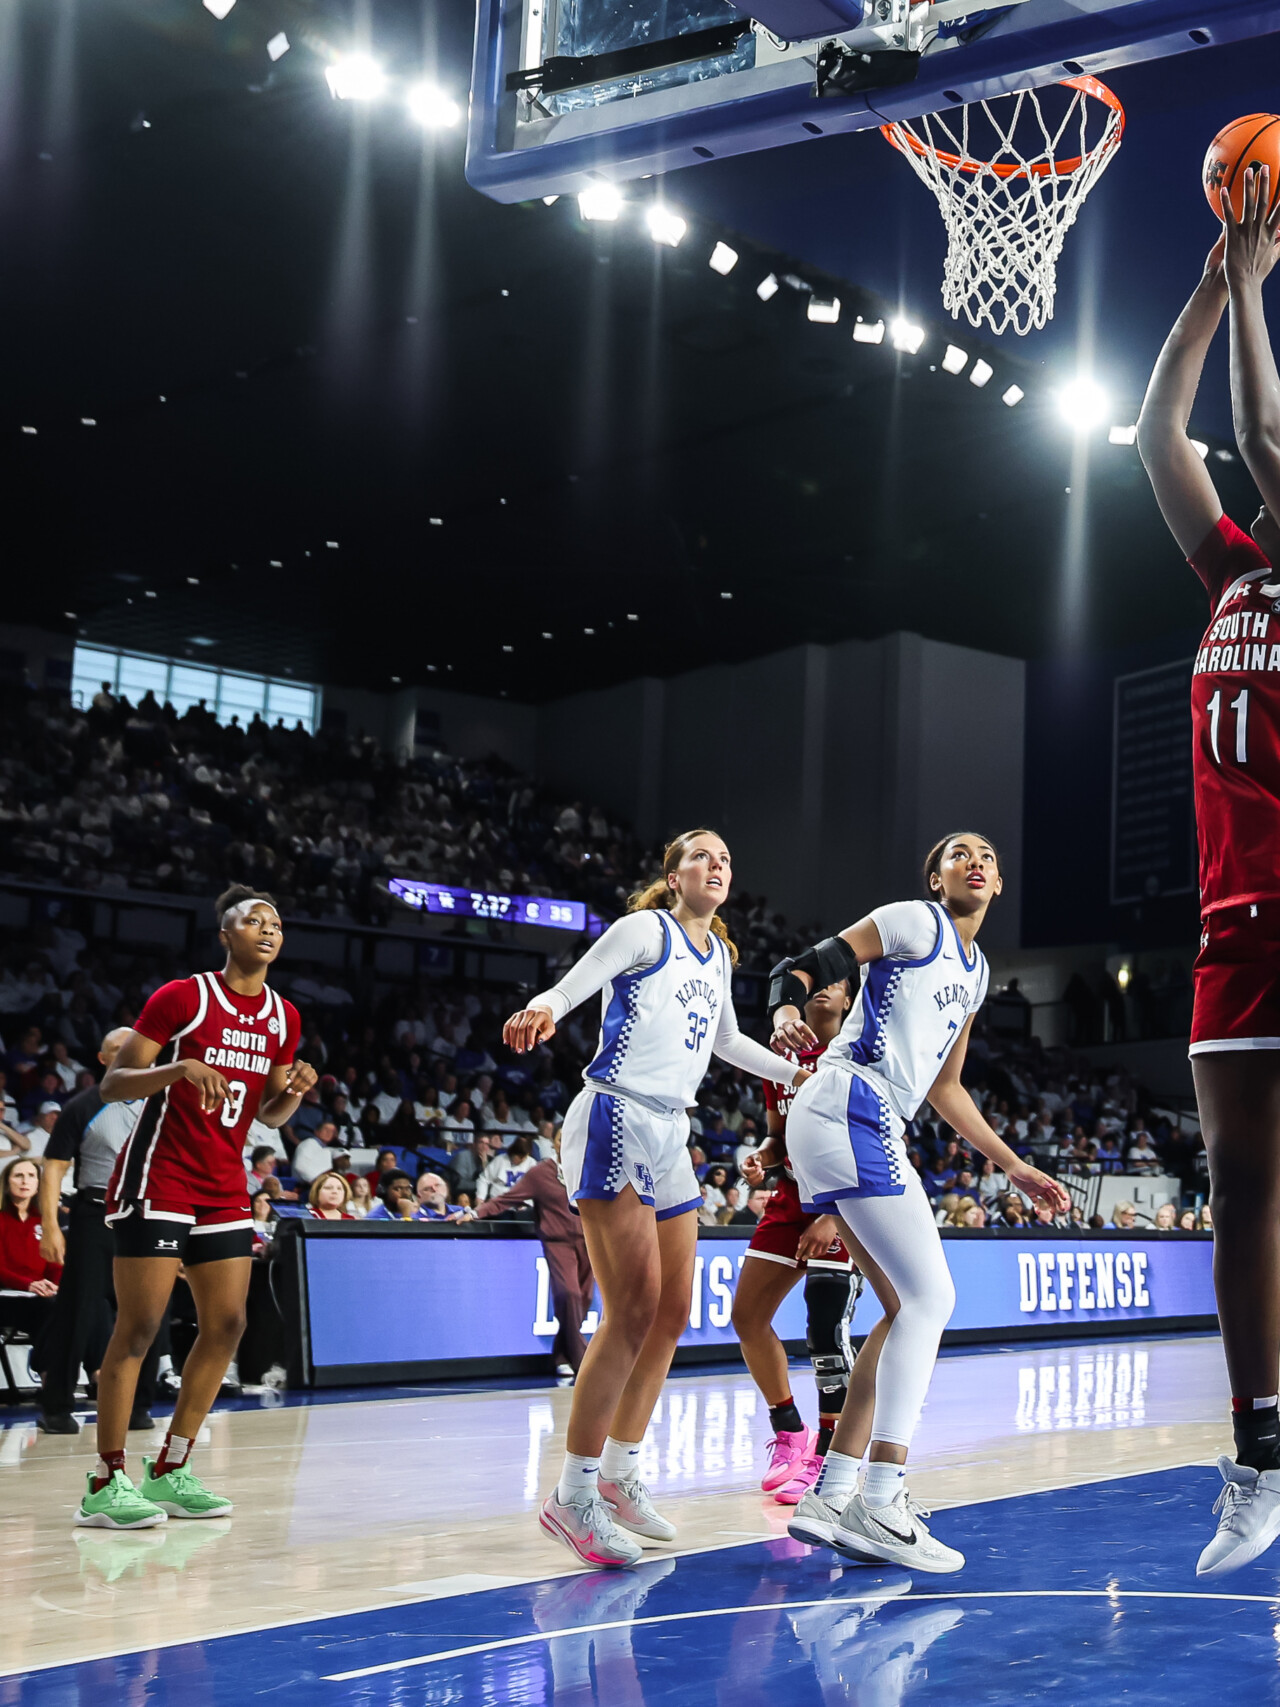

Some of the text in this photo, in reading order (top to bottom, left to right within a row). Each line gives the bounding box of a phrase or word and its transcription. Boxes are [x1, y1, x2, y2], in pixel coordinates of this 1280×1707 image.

[1208, 611, 1270, 642] SOUTH
[1206, 690, 1249, 765] 11
[550, 904, 573, 923] 35
[675, 978, 718, 1021] KENTUCK
[221, 1027, 268, 1053] SOUTH
[684, 1011, 709, 1053] 32
[936, 1019, 958, 1061] 7
[204, 1046, 272, 1076] CAROLINA
[1017, 1250, 1151, 1313] DEFENSE
